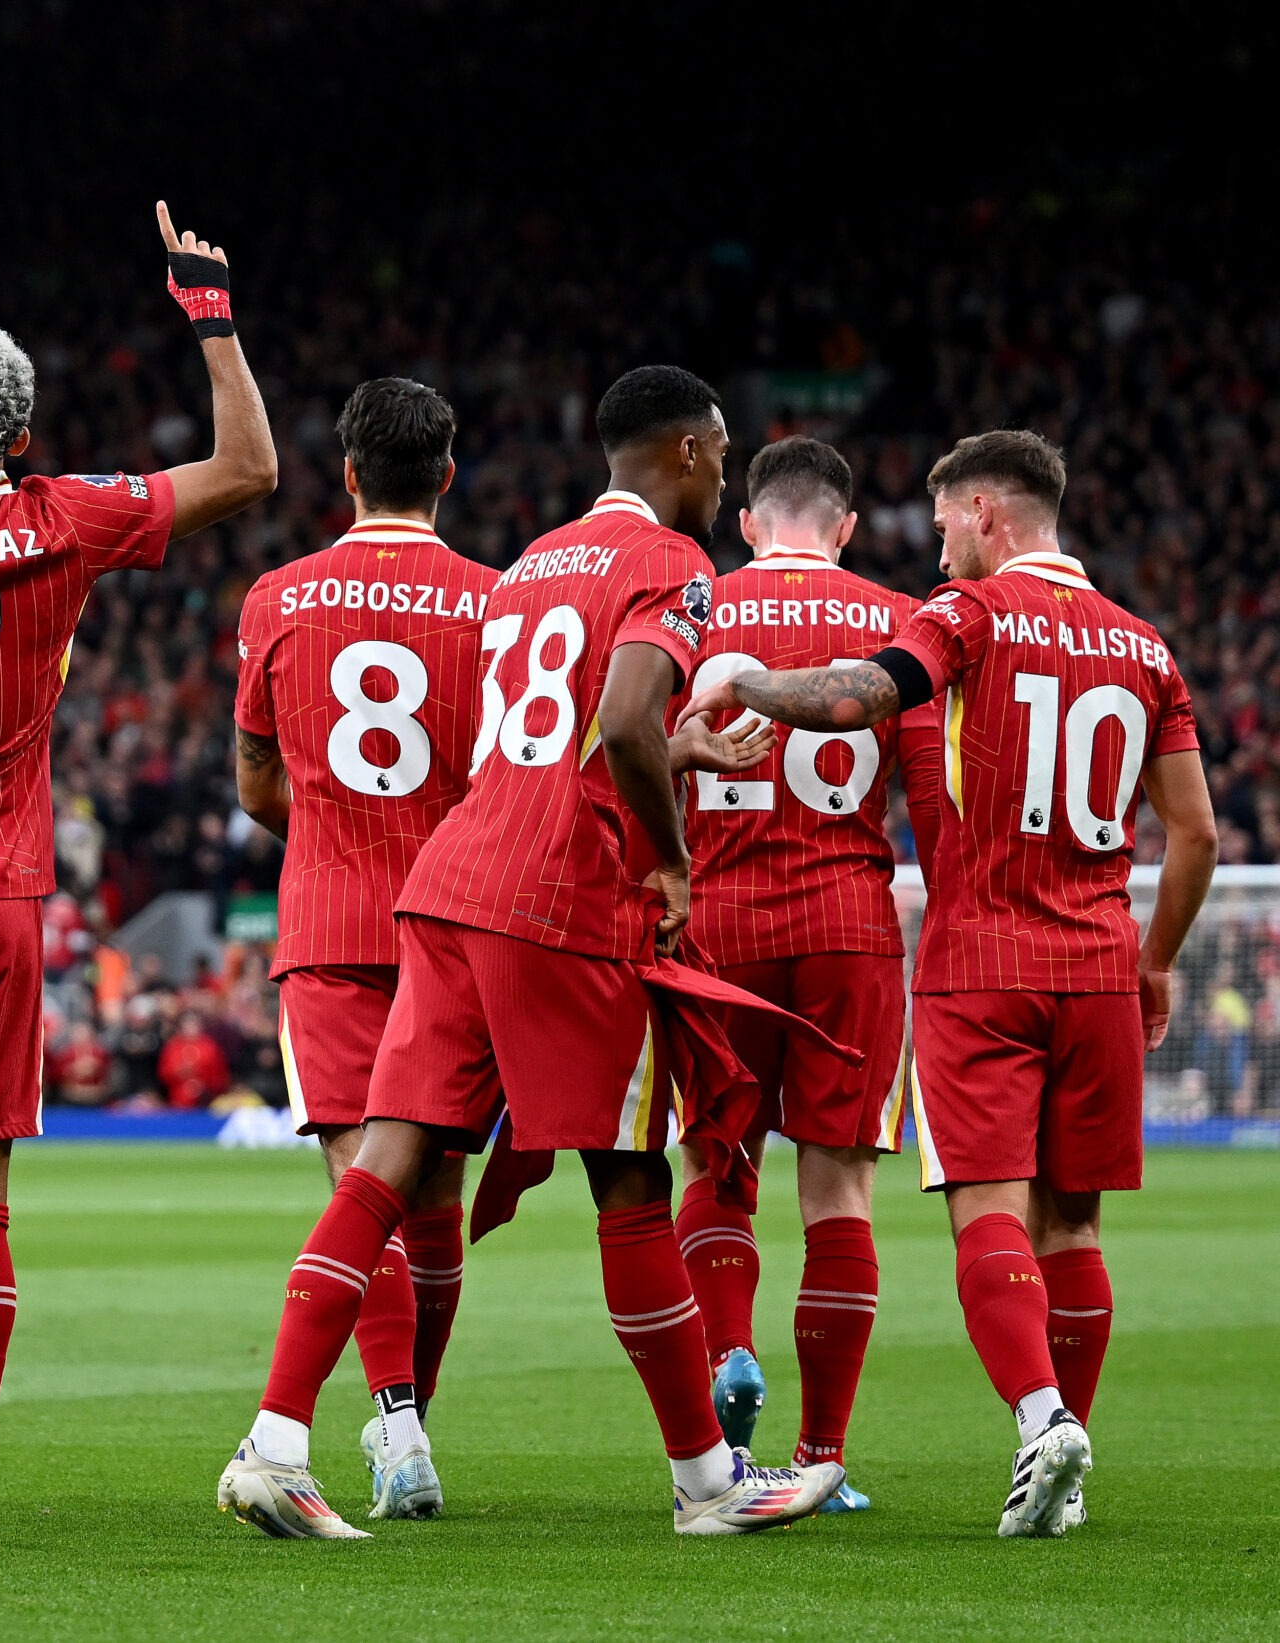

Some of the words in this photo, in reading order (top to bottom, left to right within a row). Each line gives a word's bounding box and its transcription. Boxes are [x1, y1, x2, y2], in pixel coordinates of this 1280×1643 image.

[492, 544, 618, 592] AVENBERCH
[281, 577, 487, 620] SZOBOSZLAI
[707, 599, 891, 634] OBERTSON
[911, 603, 962, 625] edia
[992, 612, 1051, 646] MAC
[1058, 621, 1170, 675] ALLISTER
[468, 604, 586, 777] 38
[327, 640, 431, 797] 8
[1015, 672, 1147, 852] 10
[711, 1257, 744, 1268] LFC
[1007, 1272, 1042, 1286] LFC
[286, 1289, 311, 1301] LFC
[795, 1328, 825, 1339] LFC
[1048, 1336, 1081, 1345] FC
[270, 1475, 313, 1491] F50
[717, 1488, 762, 1513] F50
